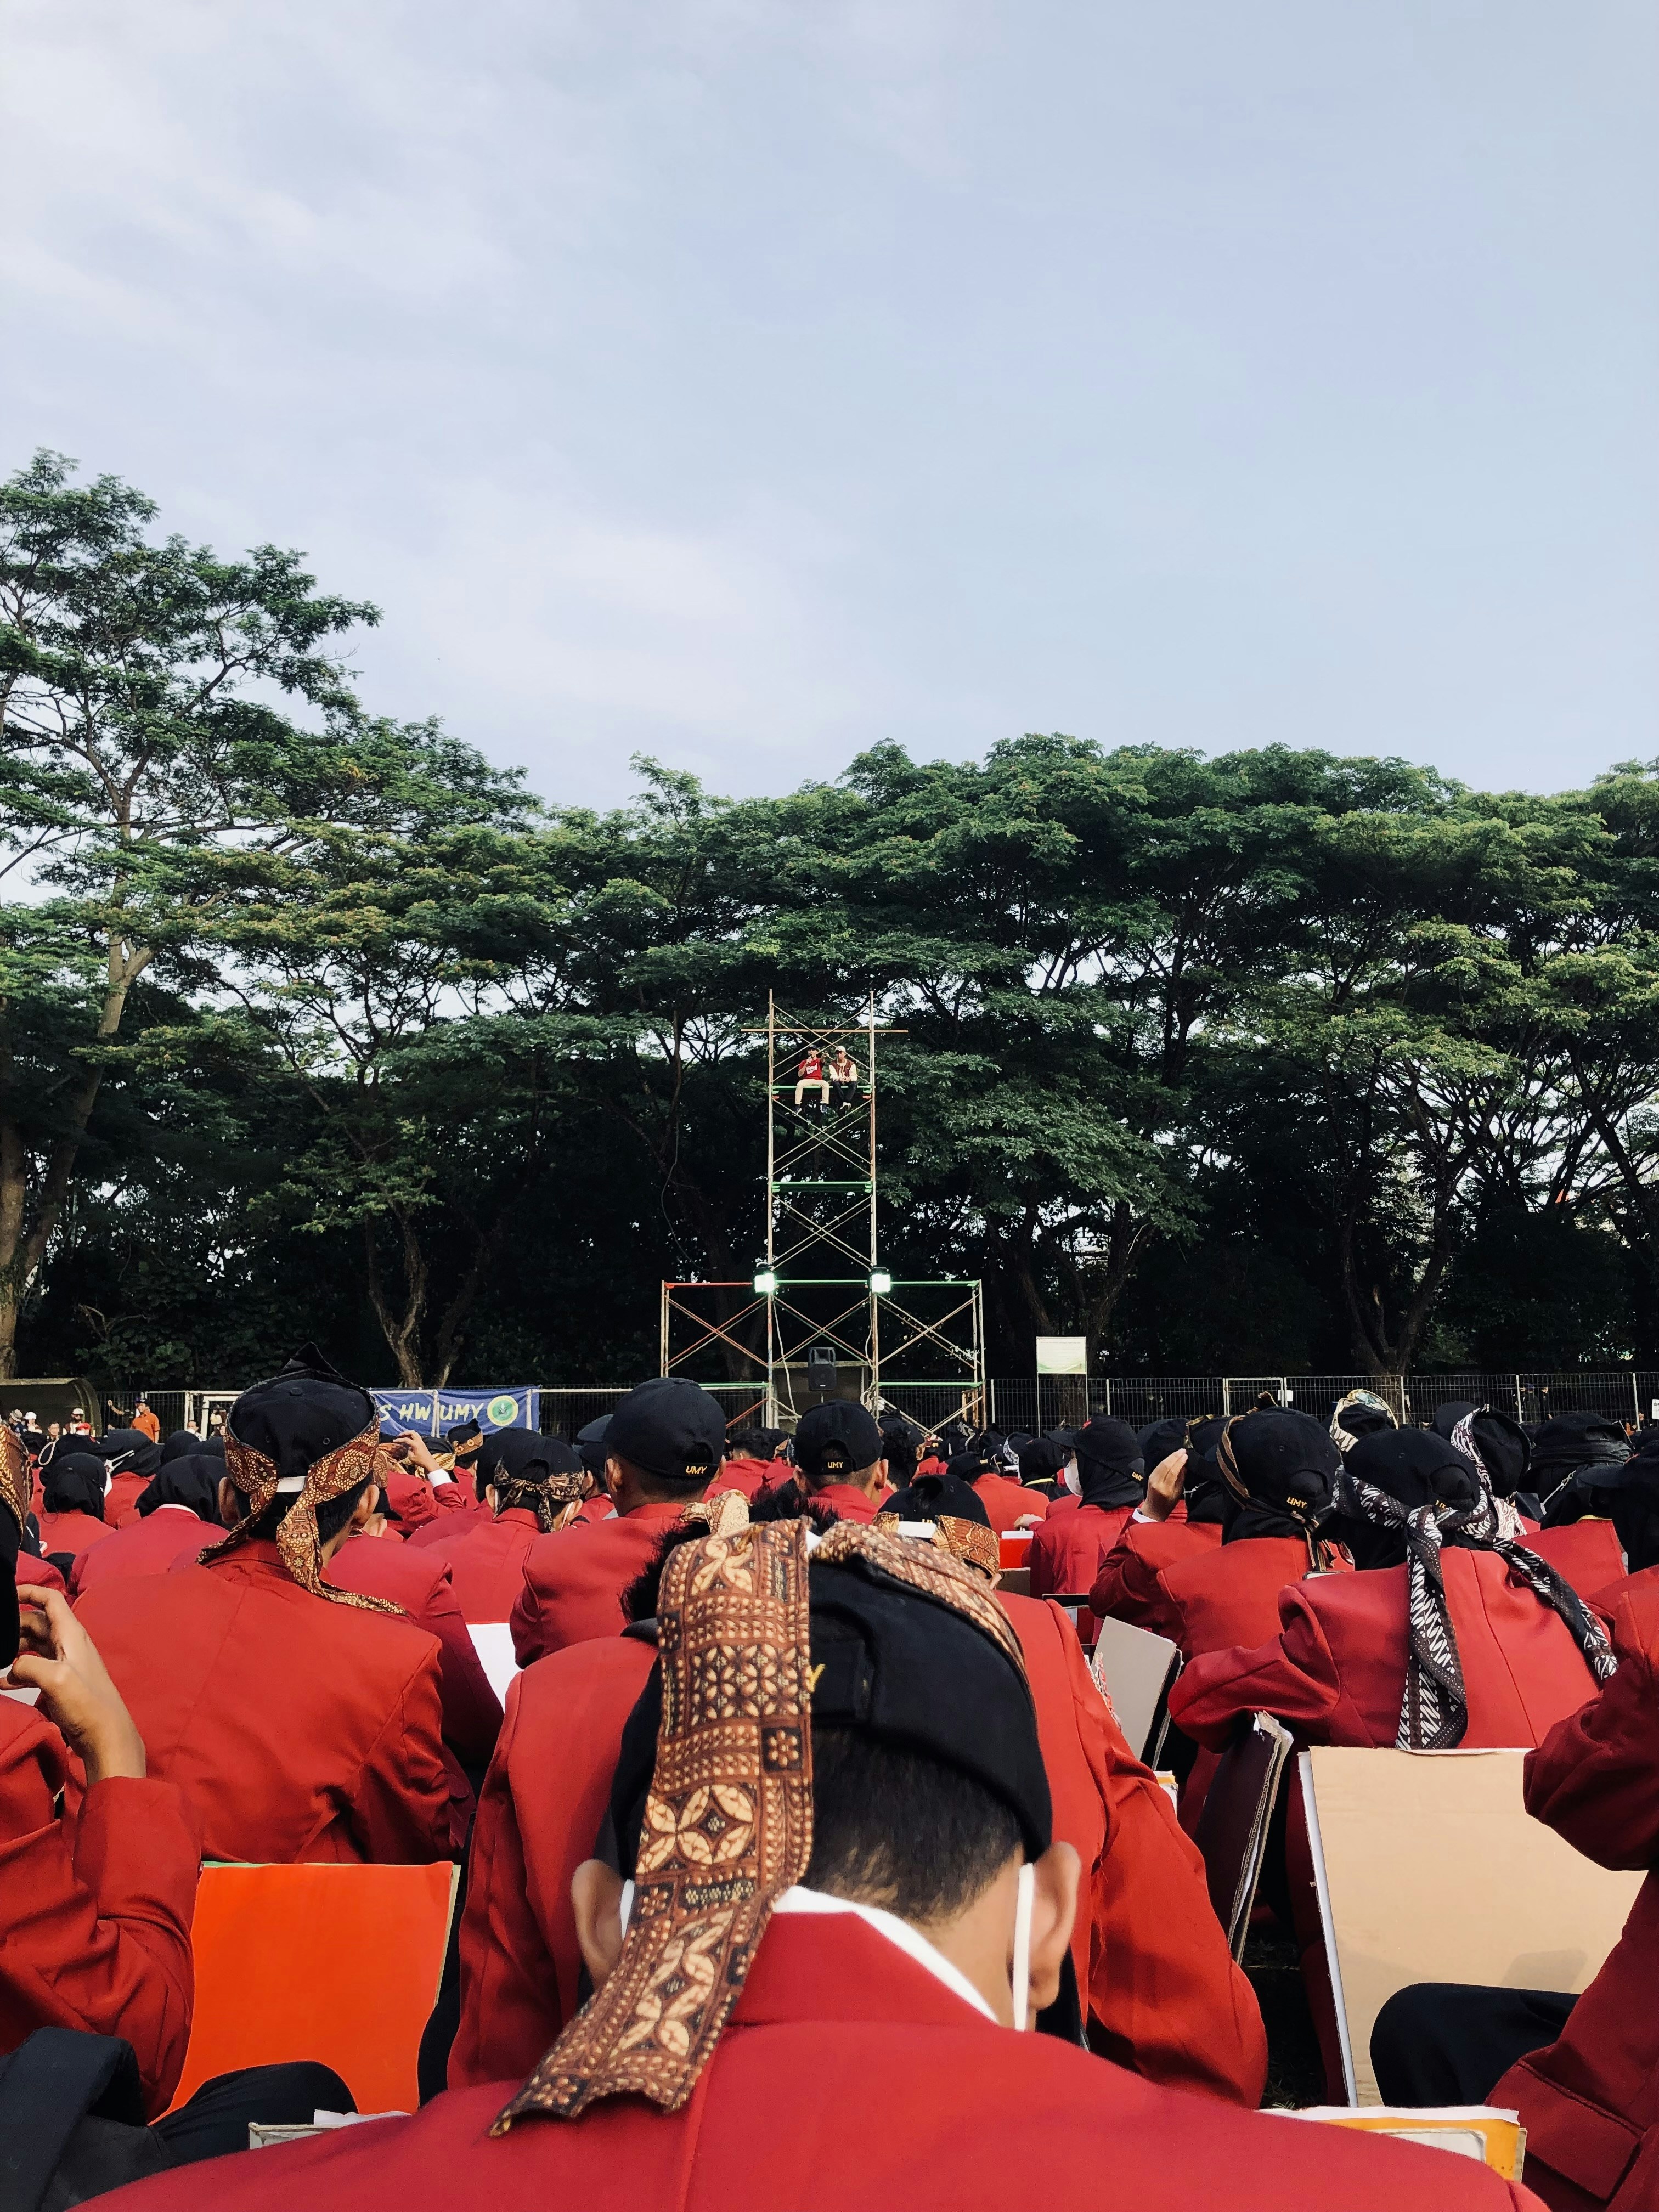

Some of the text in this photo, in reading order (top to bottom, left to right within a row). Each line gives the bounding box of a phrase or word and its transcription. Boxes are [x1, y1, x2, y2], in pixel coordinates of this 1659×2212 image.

[399, 1403, 431, 1422] HW
[440, 1402, 484, 1422] UMY
[686, 1465, 707, 1475] UMY
[1286, 1496, 1307, 1509] UMY
